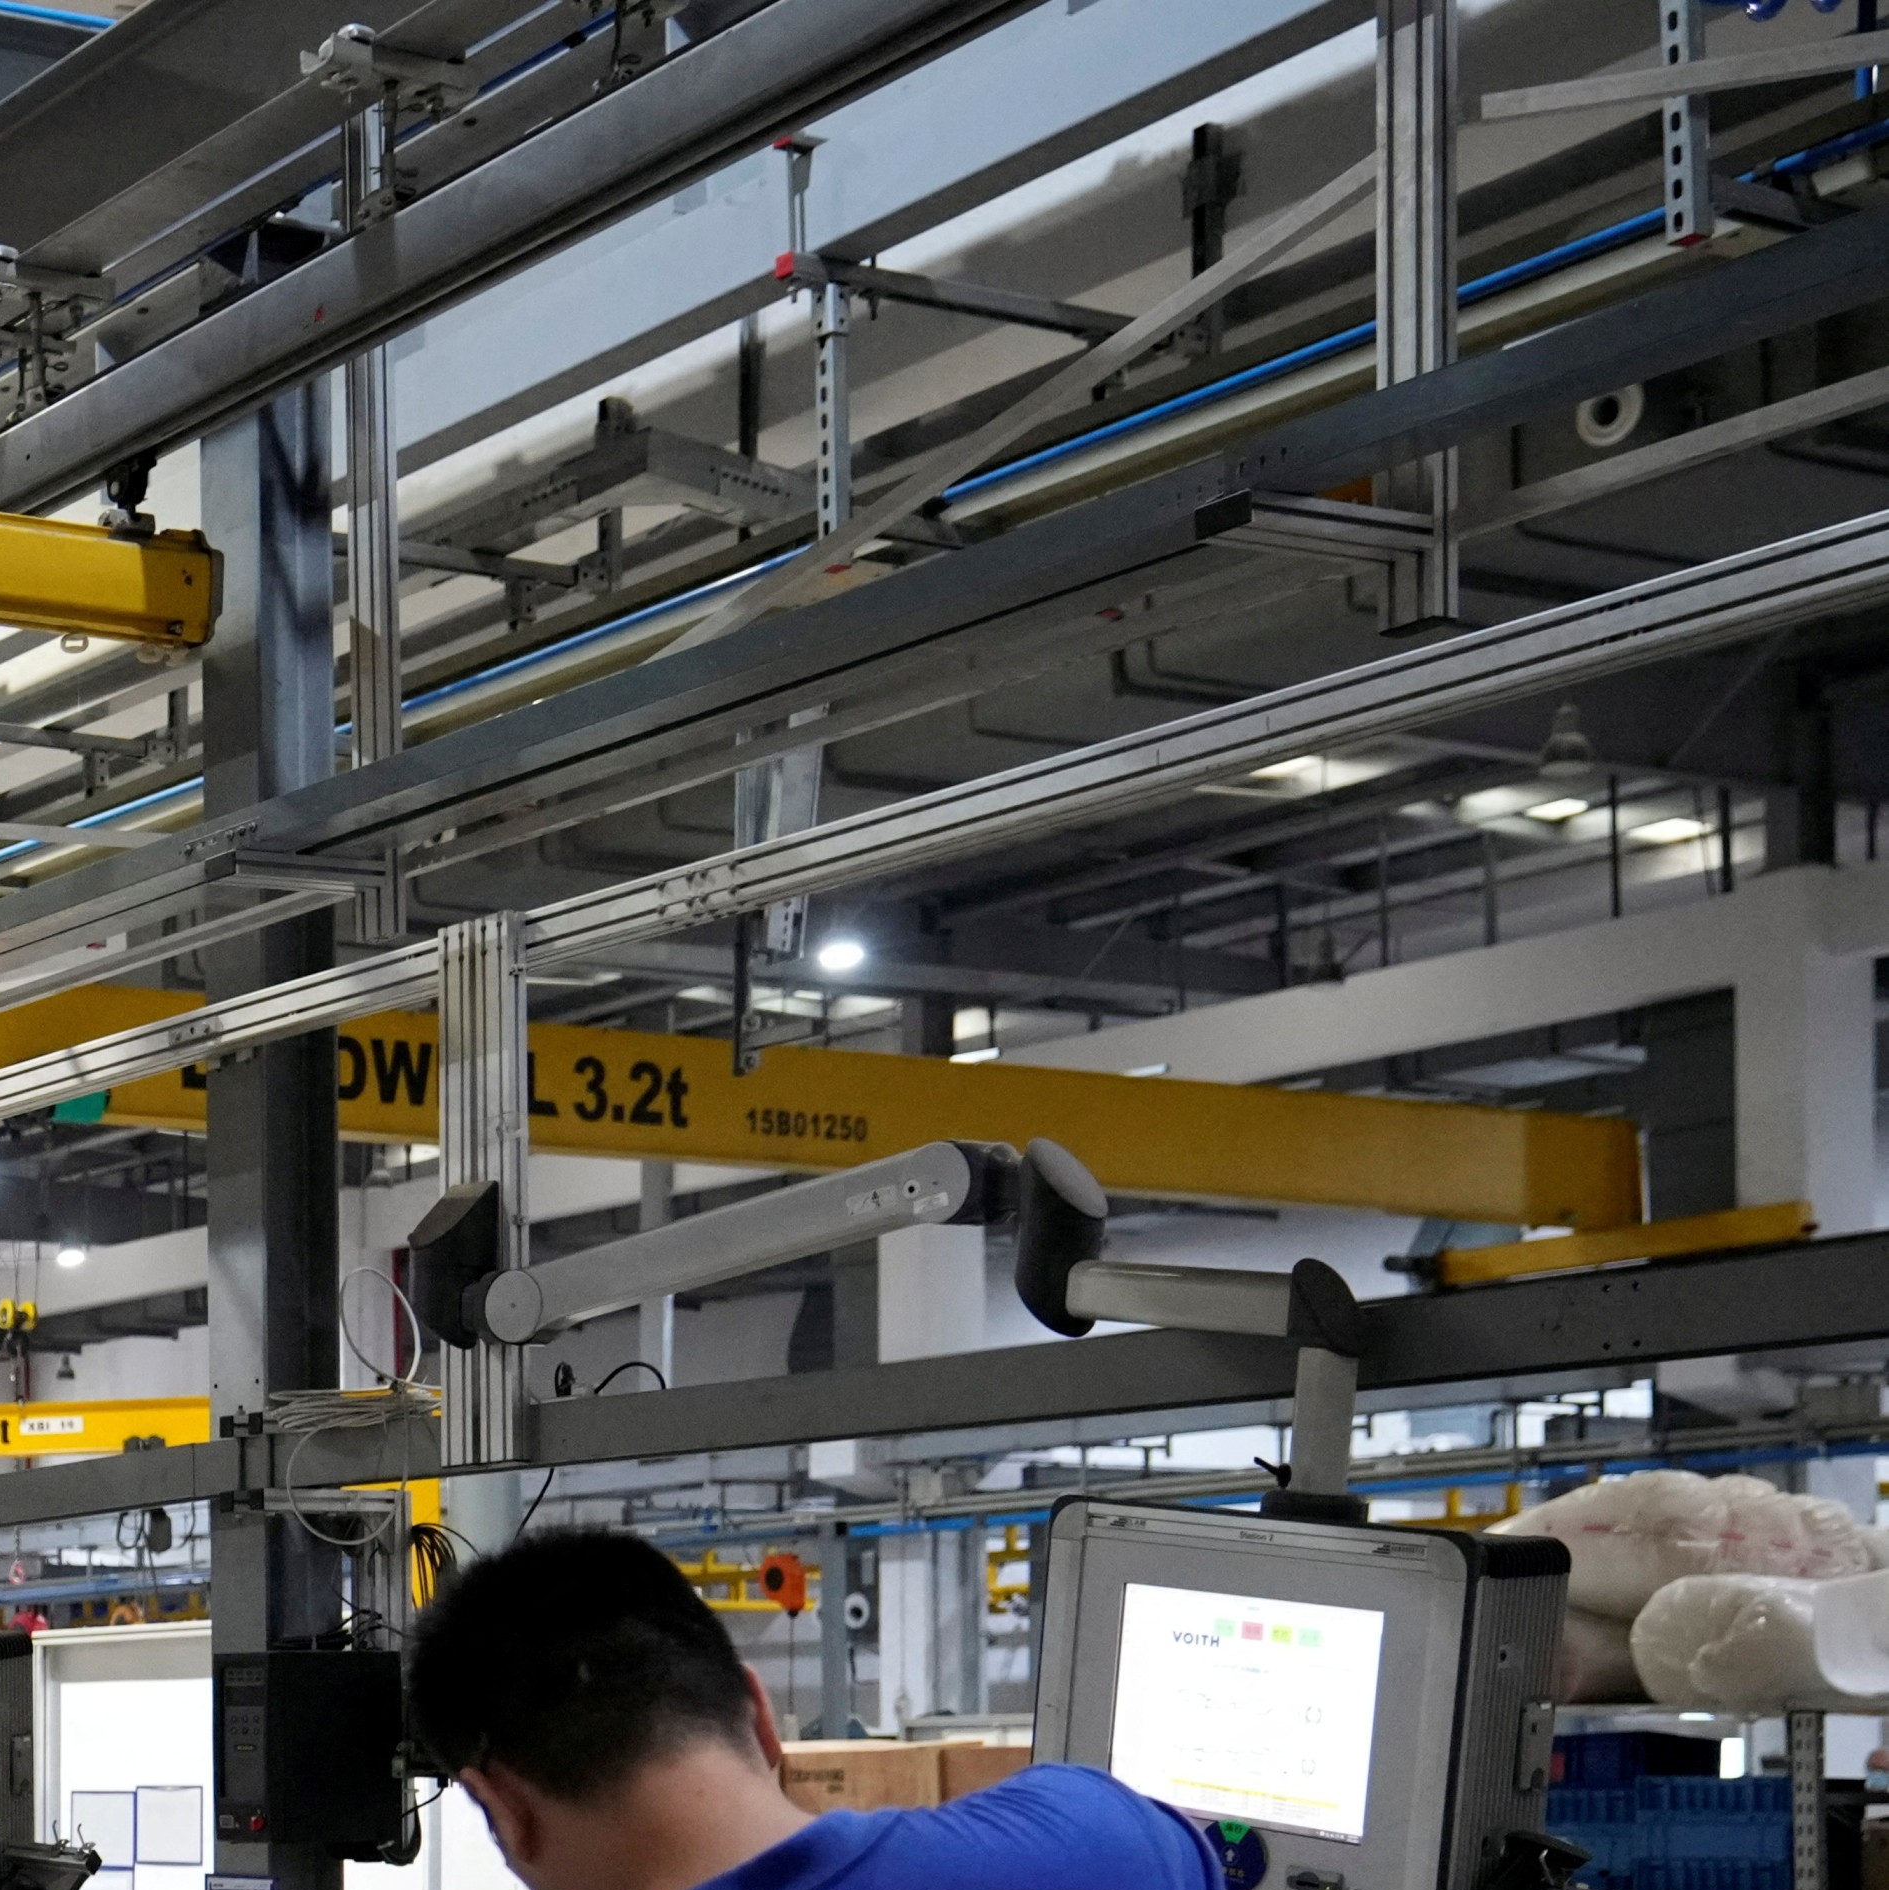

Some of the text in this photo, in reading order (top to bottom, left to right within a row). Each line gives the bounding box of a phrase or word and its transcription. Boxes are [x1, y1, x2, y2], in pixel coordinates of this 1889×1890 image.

[573, 1056, 689, 1128] 3.2t
[745, 1107, 868, 1142] 15B01250
[1172, 1630, 1220, 1648] VOITH
